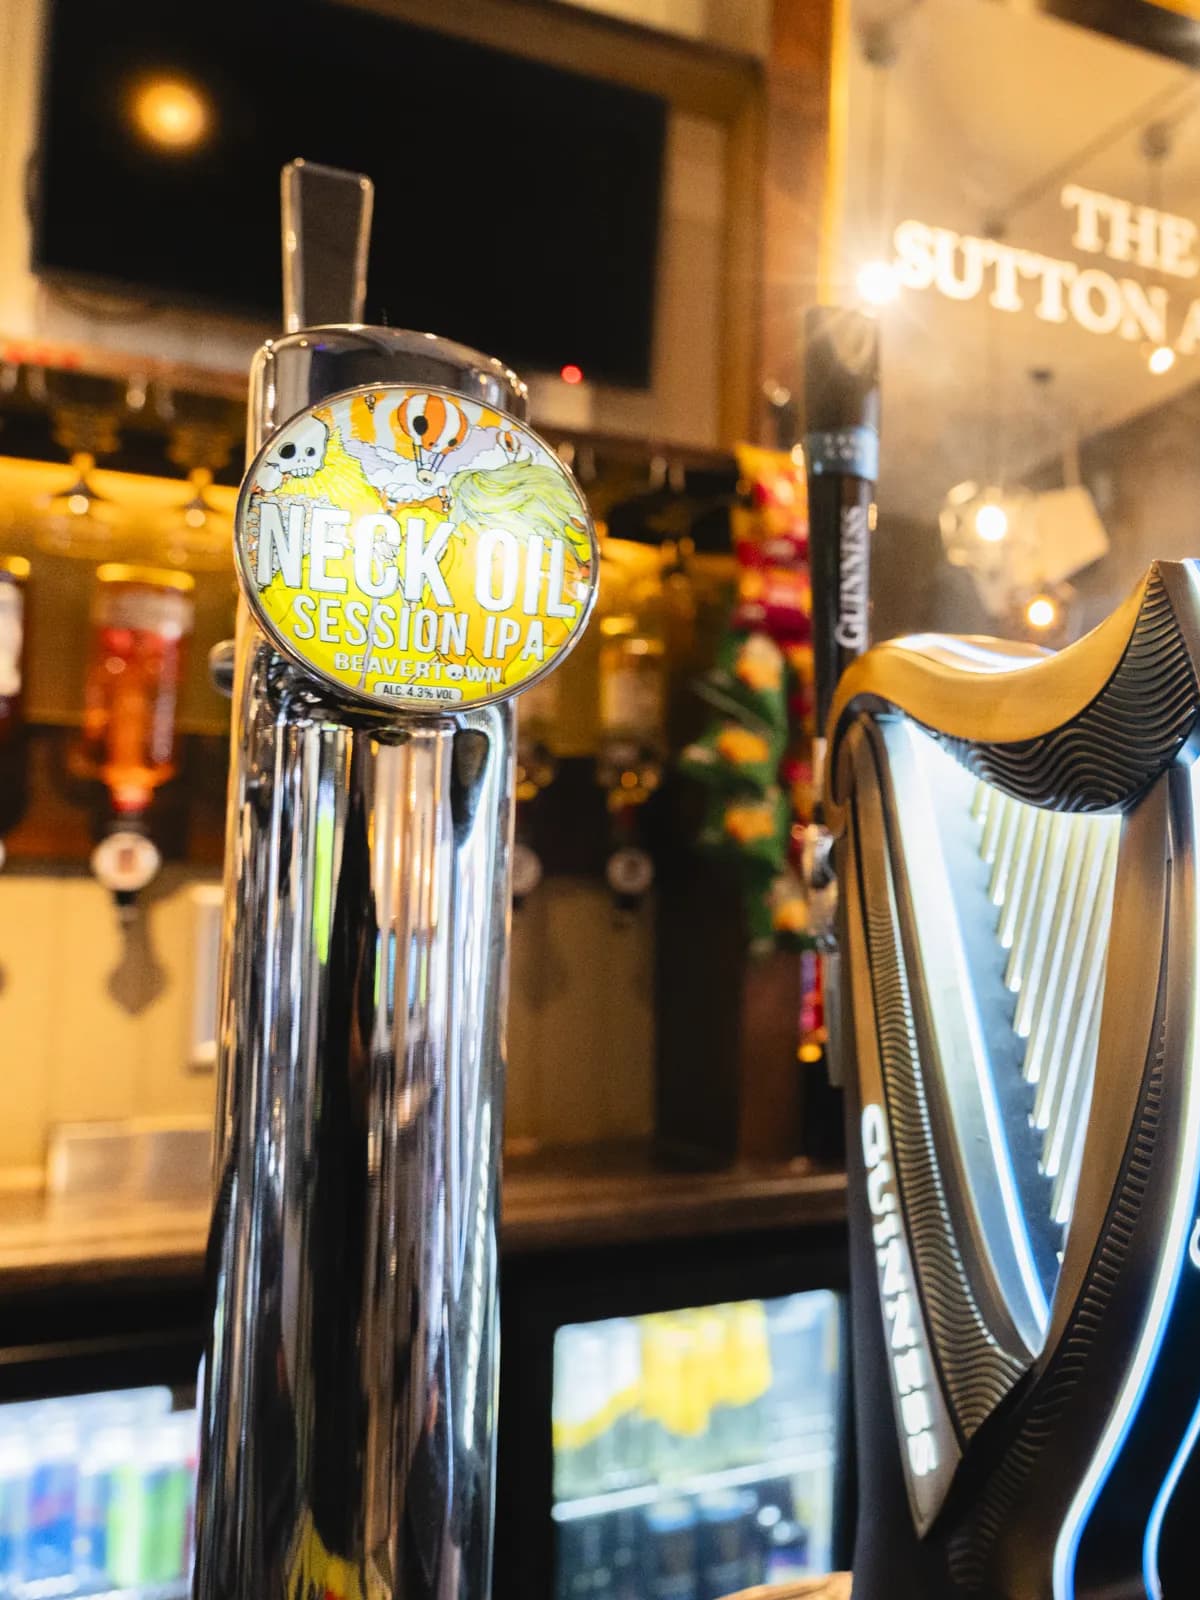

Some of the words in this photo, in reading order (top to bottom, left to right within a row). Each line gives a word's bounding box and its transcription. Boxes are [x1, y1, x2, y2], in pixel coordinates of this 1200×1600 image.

[1061, 184, 1200, 278] THE
[893, 219, 1169, 343] SUTTON
[257, 502, 456, 607] NECK
[476, 528, 577, 618] OIL
[293, 594, 469, 656] SESSION
[483, 616, 544, 661] IPA
[334, 652, 502, 683] BEAVERTOWN
[407, 687, 433, 699] 4.3%
[436, 689, 453, 700] VOL
